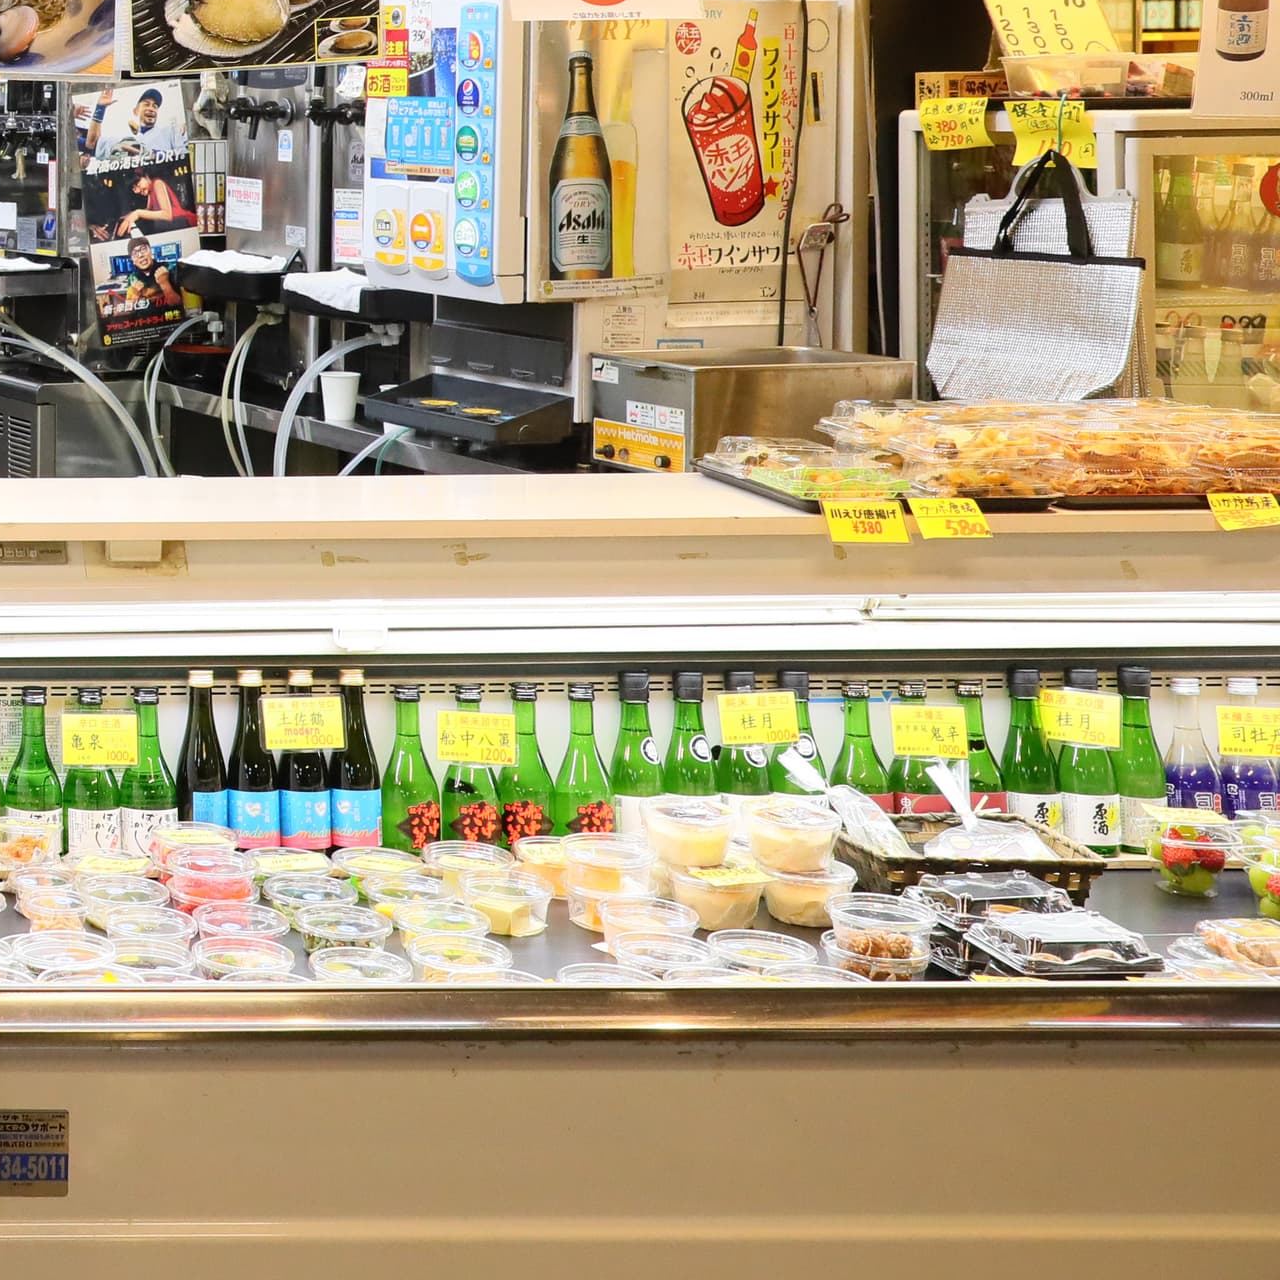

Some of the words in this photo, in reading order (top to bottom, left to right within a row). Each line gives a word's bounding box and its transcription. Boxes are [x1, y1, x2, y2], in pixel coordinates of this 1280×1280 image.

[576, 234, 589, 245] 生
[830, 508, 897, 521] 川えび唐揚げ
[852, 521, 883, 535] ¥380
[279, 713, 325, 727] 土佐鶴
[740, 712, 775, 731] 桂月
[1055, 710, 1091, 731] 桂月
[71, 733, 103, 751] 亀泉
[1092, 802, 1111, 838] 原酒
